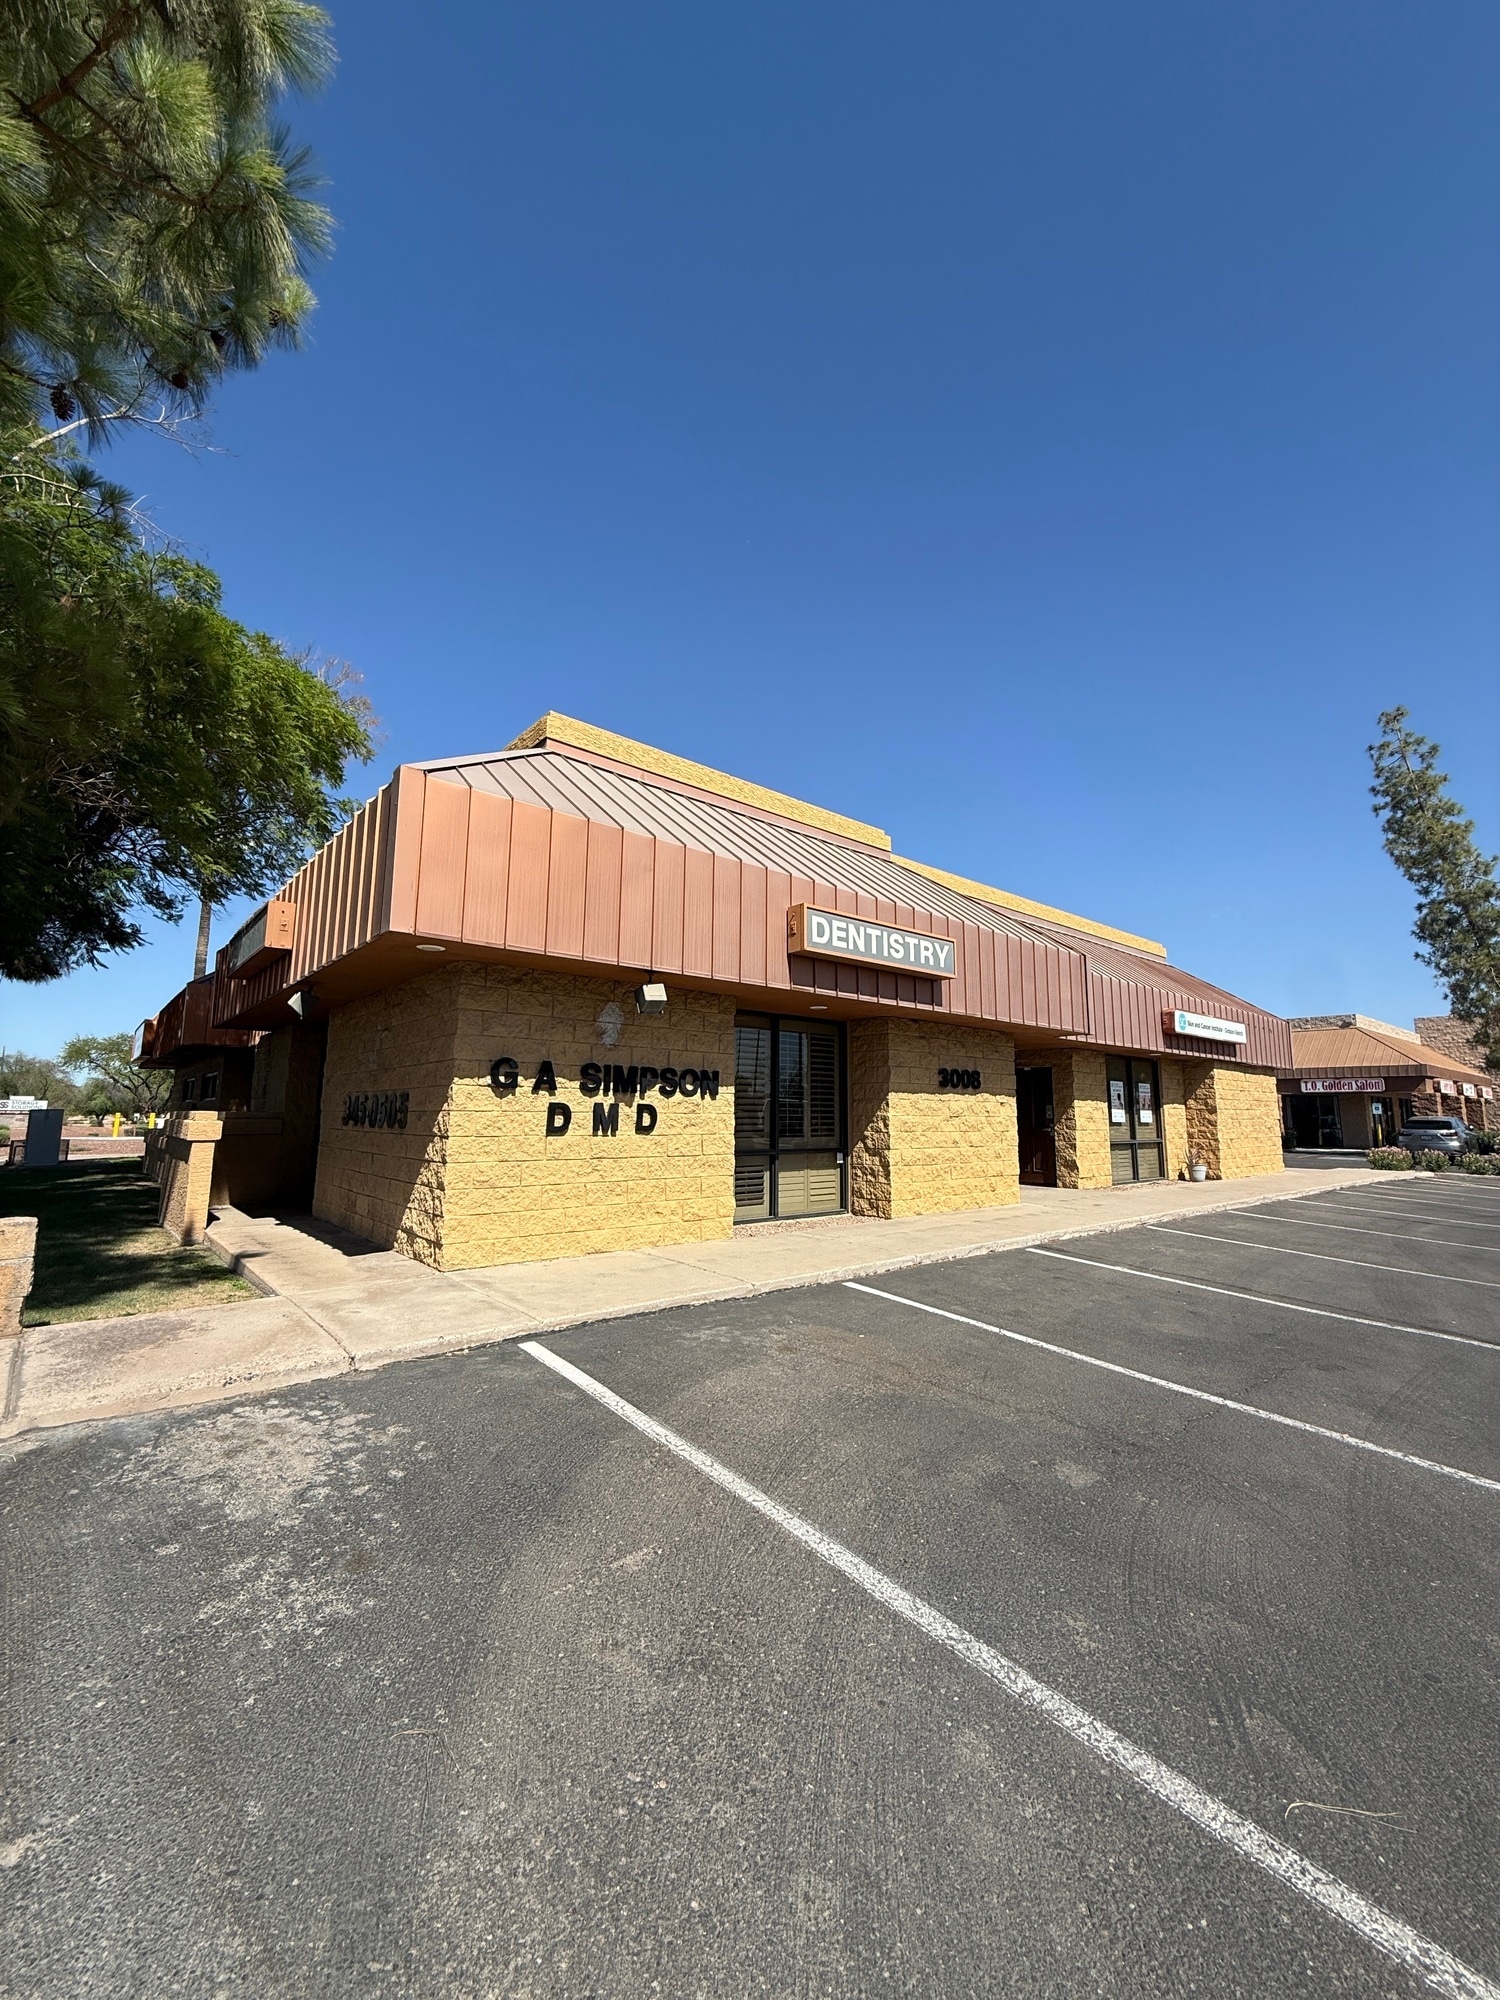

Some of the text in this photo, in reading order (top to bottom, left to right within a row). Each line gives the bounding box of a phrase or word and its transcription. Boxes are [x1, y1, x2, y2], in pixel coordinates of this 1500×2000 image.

[811, 914, 950, 968] DENTISTRY
[1201, 1022, 1211, 1031] Cancer
[1211, 1025, 1223, 1033] Institute
[490, 1056, 720, 1100] G A SIMPSON
[938, 1067, 982, 1090] 3008
[1302, 1079, 1380, 1091] T.O. Golden Salon
[341, 1091, 410, 1129] 345-0505
[547, 1102, 658, 1137] D M D
